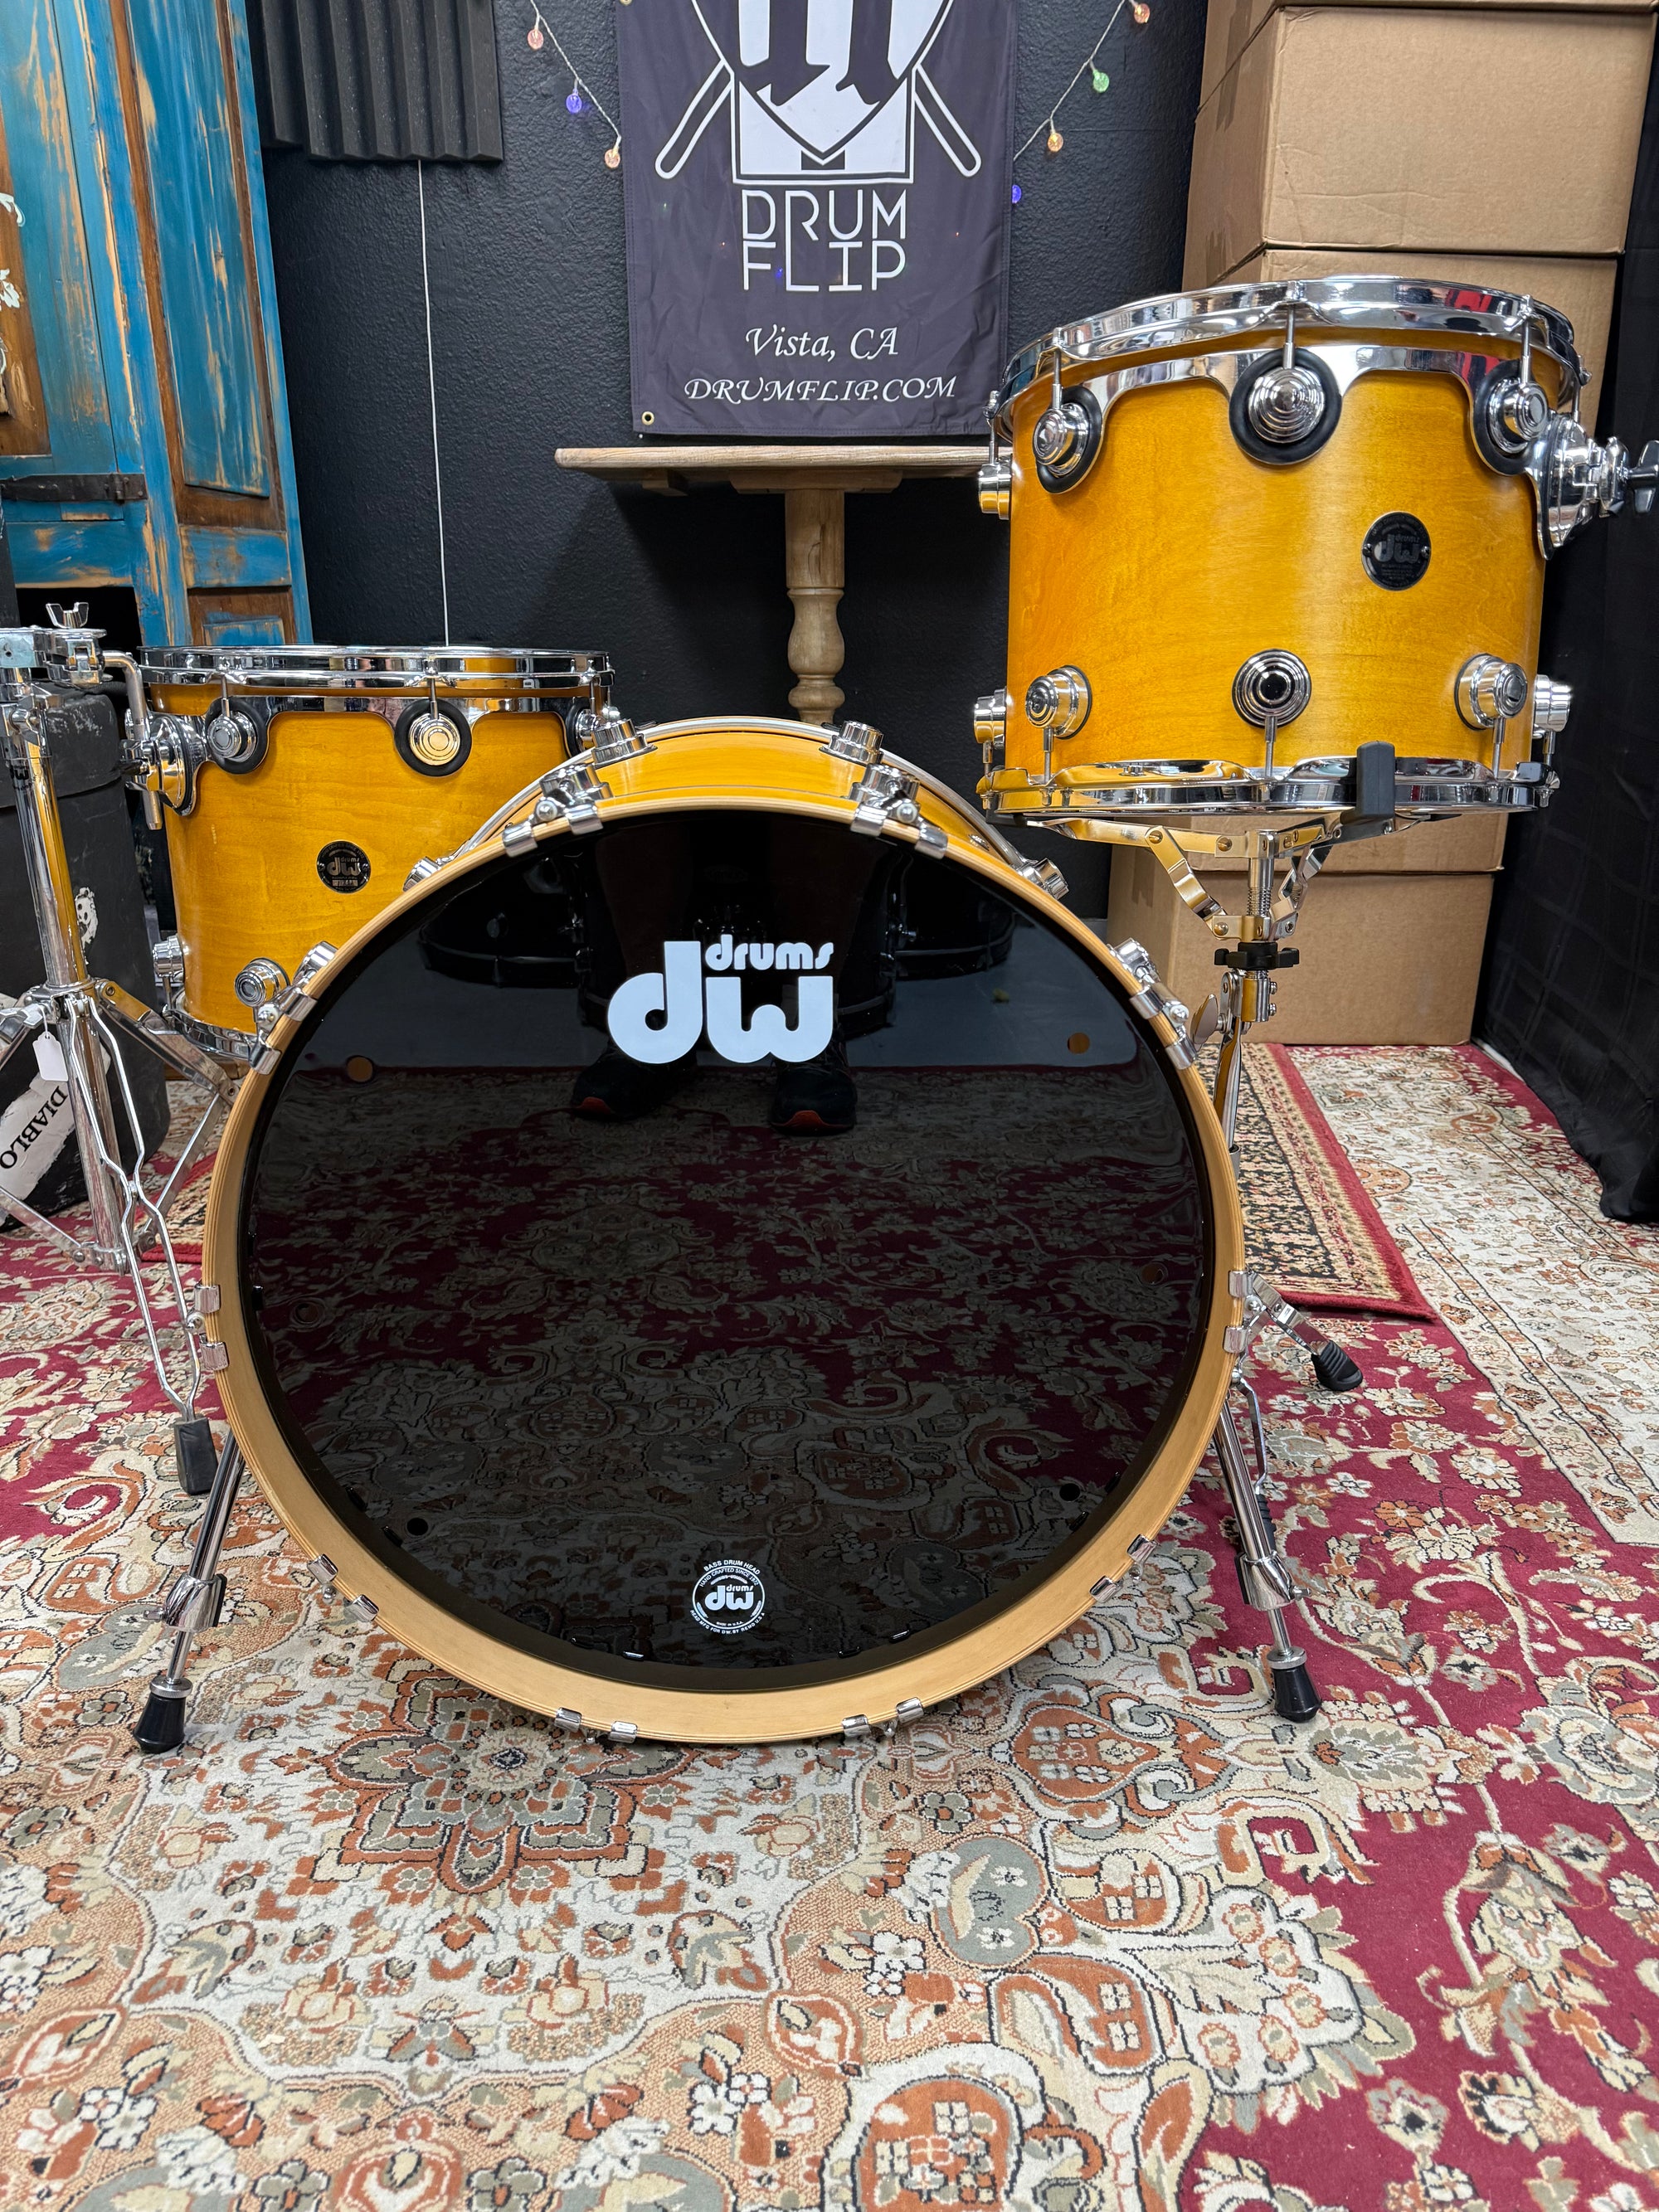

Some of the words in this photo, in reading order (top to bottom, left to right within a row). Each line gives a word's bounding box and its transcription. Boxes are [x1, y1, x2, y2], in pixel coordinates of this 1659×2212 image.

[742, 189, 907, 241] DRUM
[742, 240, 907, 292] FLIP
[745, 324, 836, 362] Vista,
[849, 327, 898, 360] CA
[684, 376, 956, 405] DRUMFLIP.COM
[327, 857, 361, 876] dw
[704, 934, 834, 971] drums
[607, 941, 834, 1064] dw
[0, 1085, 69, 1169] DIABLO
[698, 1574, 712, 1587] HAND
[711, 1568, 735, 1577] CRAFTED
[735, 1568, 751, 1578] SINCE
[703, 1561, 722, 1572] BASS
[743, 1563, 761, 1575] HEAD
[704, 1585, 754, 1611] dw
[690, 1610, 700, 1621] HEAD
[741, 1622, 756, 1632] REMO
